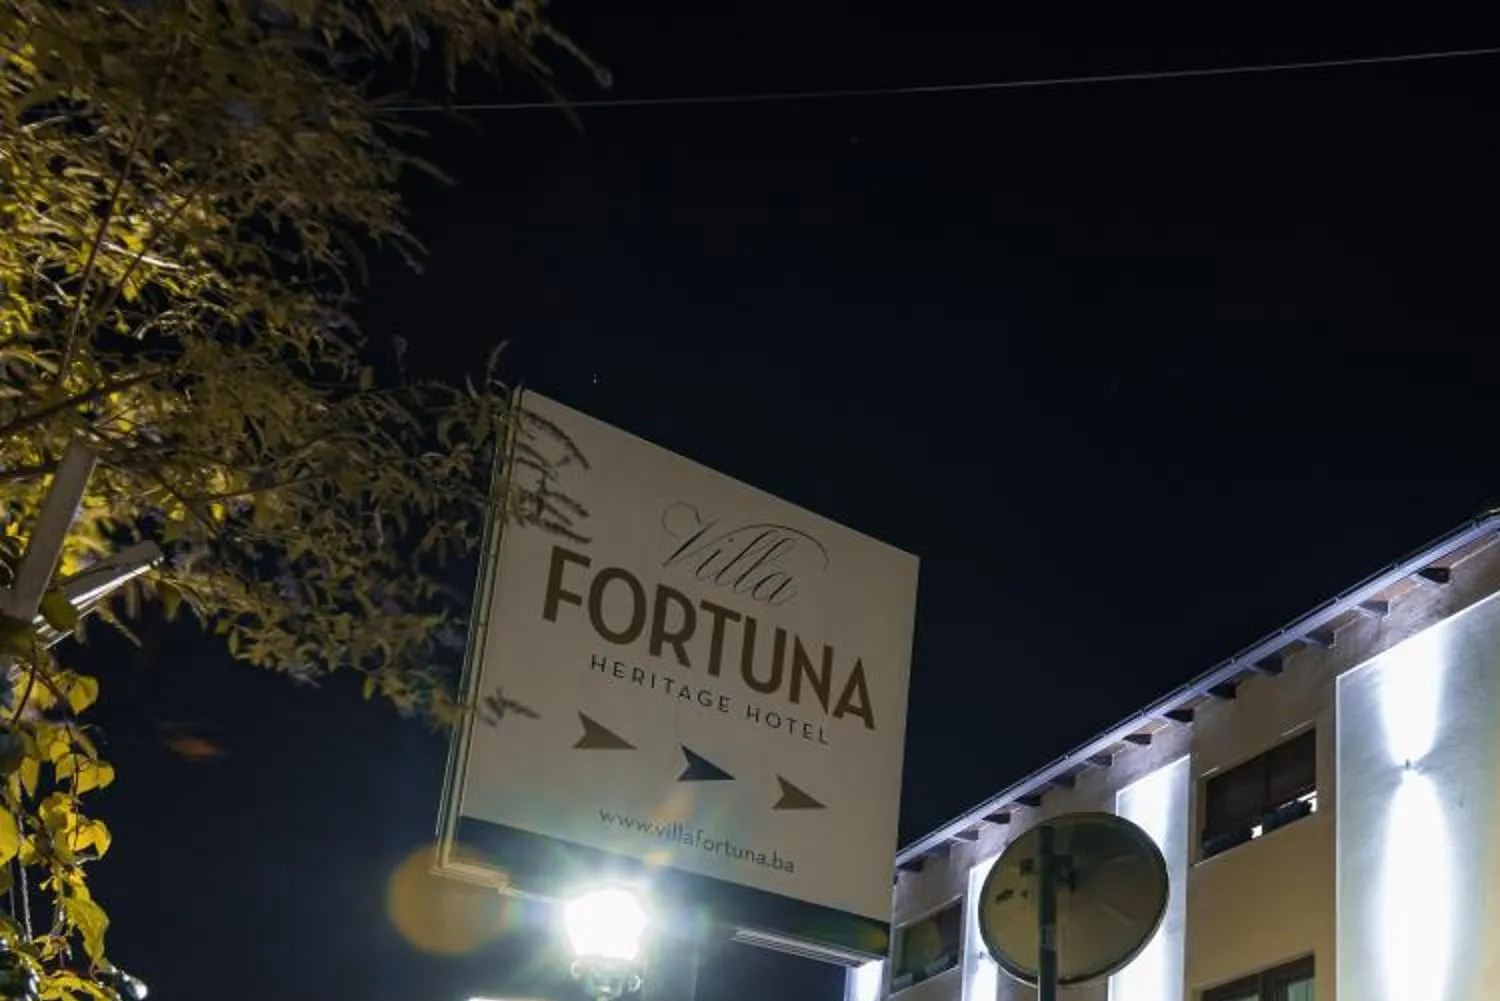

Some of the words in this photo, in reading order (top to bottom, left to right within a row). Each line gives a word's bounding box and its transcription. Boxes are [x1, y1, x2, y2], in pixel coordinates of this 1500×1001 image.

[660, 501, 830, 606] Villa
[542, 546, 876, 730] FORTUNA
[591, 654, 732, 713] HERITAGE
[746, 704, 829, 745] HOTEL
[599, 808, 796, 873] www.villafortuna.ba
